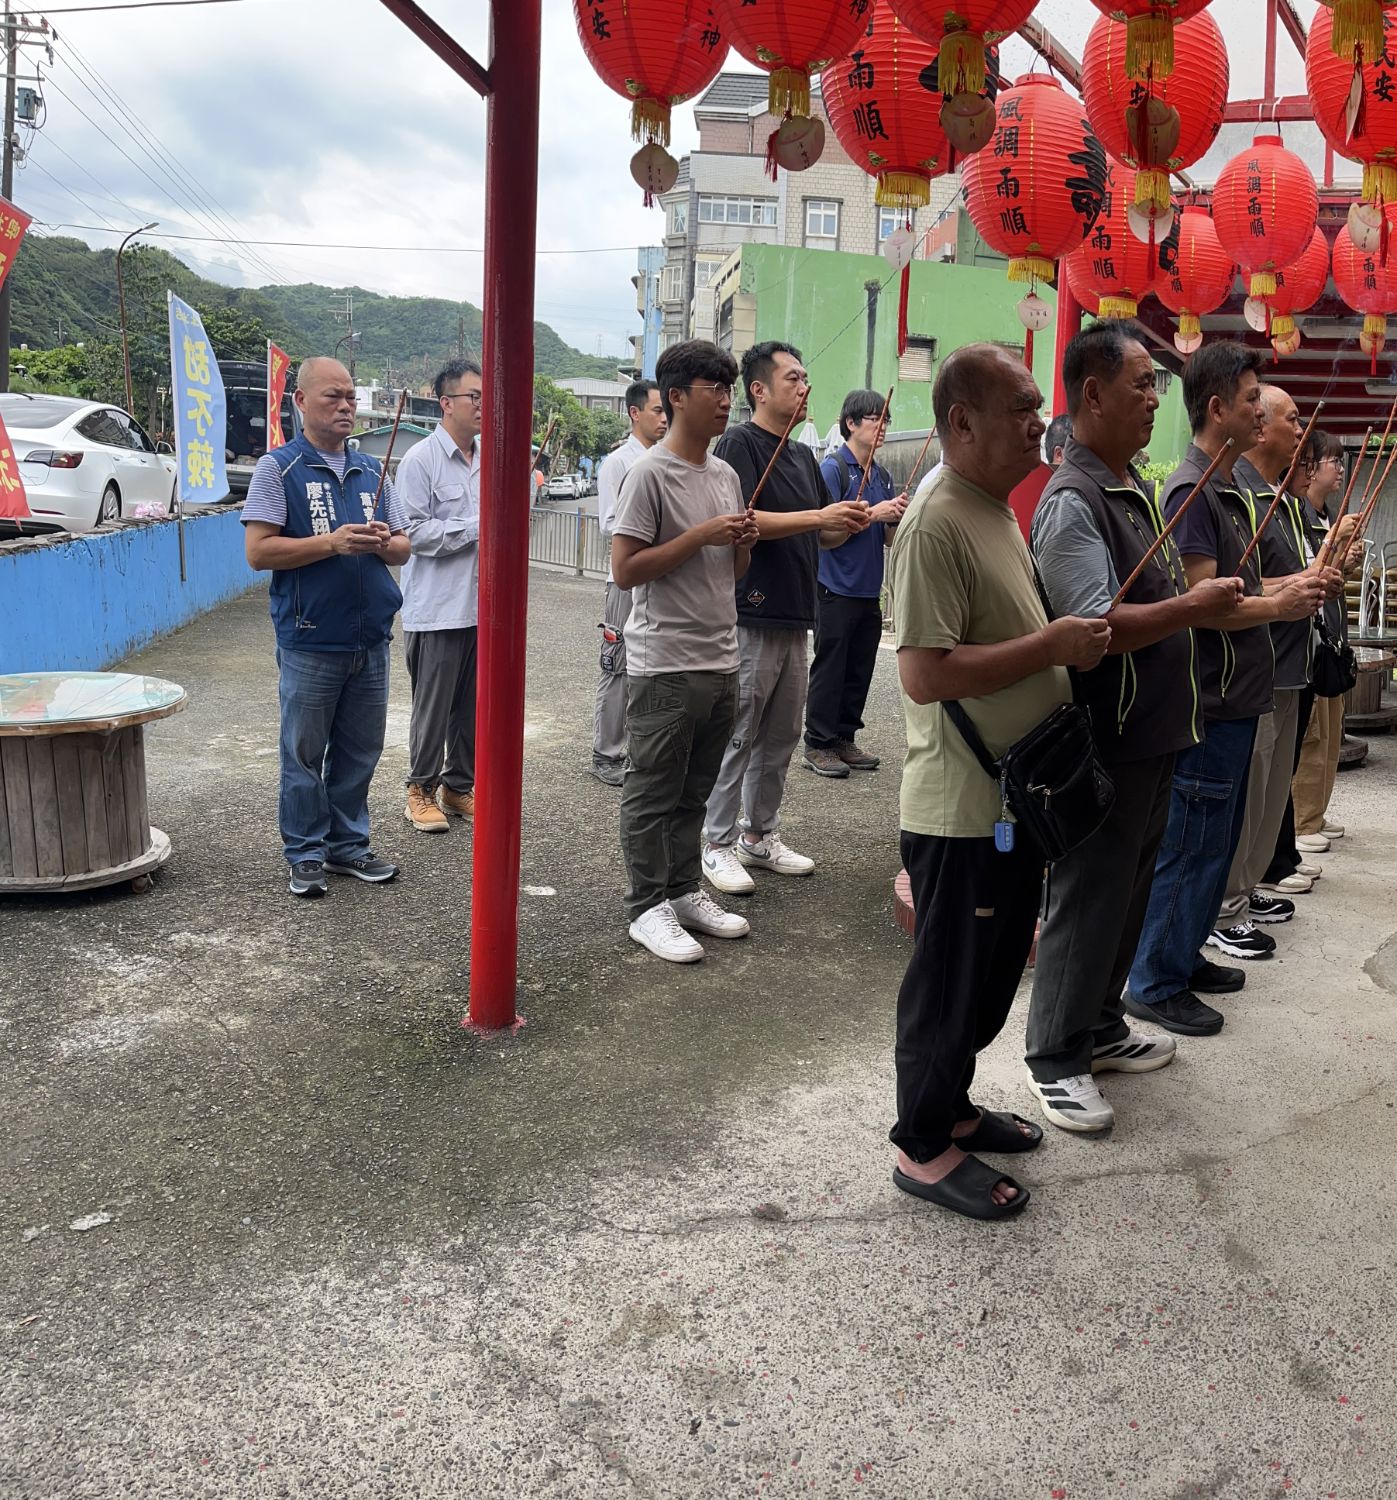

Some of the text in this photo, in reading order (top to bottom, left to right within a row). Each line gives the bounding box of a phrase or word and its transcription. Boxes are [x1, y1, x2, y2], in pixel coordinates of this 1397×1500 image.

[848, 18, 889, 141] 雨順
[994, 96, 1031, 236] 風調雨順
[1246, 160, 1266, 238] 風調雨順
[305, 482, 331, 536] 廖先翔
